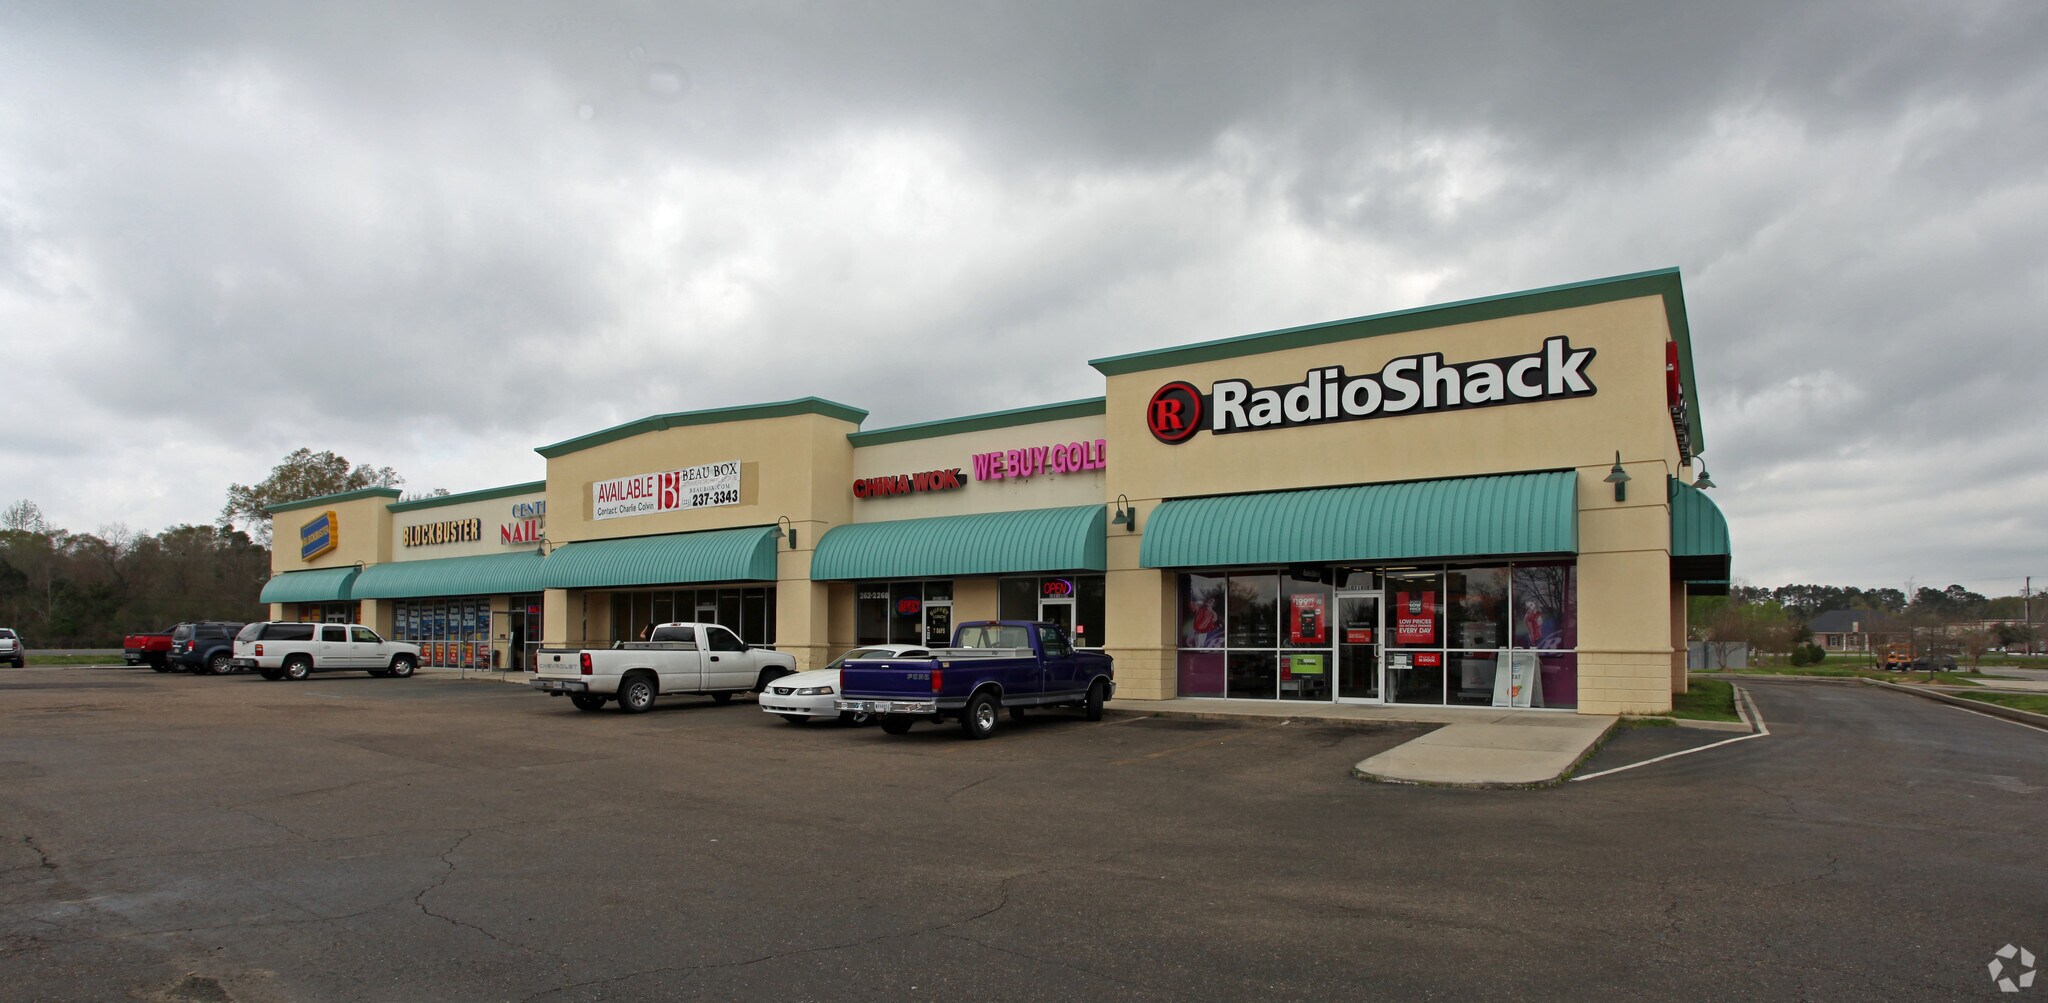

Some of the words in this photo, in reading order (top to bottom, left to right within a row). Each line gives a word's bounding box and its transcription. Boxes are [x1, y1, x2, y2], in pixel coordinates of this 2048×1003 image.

[1154, 400, 1184, 433] R
[1213, 339, 1590, 430] RadioShack
[682, 467, 710, 482] BEAU
[714, 462, 738, 477] BOX
[972, 452, 1003, 481] WE
[1007, 446, 1049, 477] BUY
[1051, 439, 1106, 473] GOLD
[598, 476, 653, 504] AVAILABLE
[853, 474, 911, 498] CHINA
[912, 467, 961, 491] WOK
[620, 503, 636, 514] Charlie
[638, 501, 654, 512] Colvin
[692, 489, 738, 507] 237-3343
[403, 518, 480, 547] BLOCKBUSTER
[1043, 582, 1067, 595] OPEN
